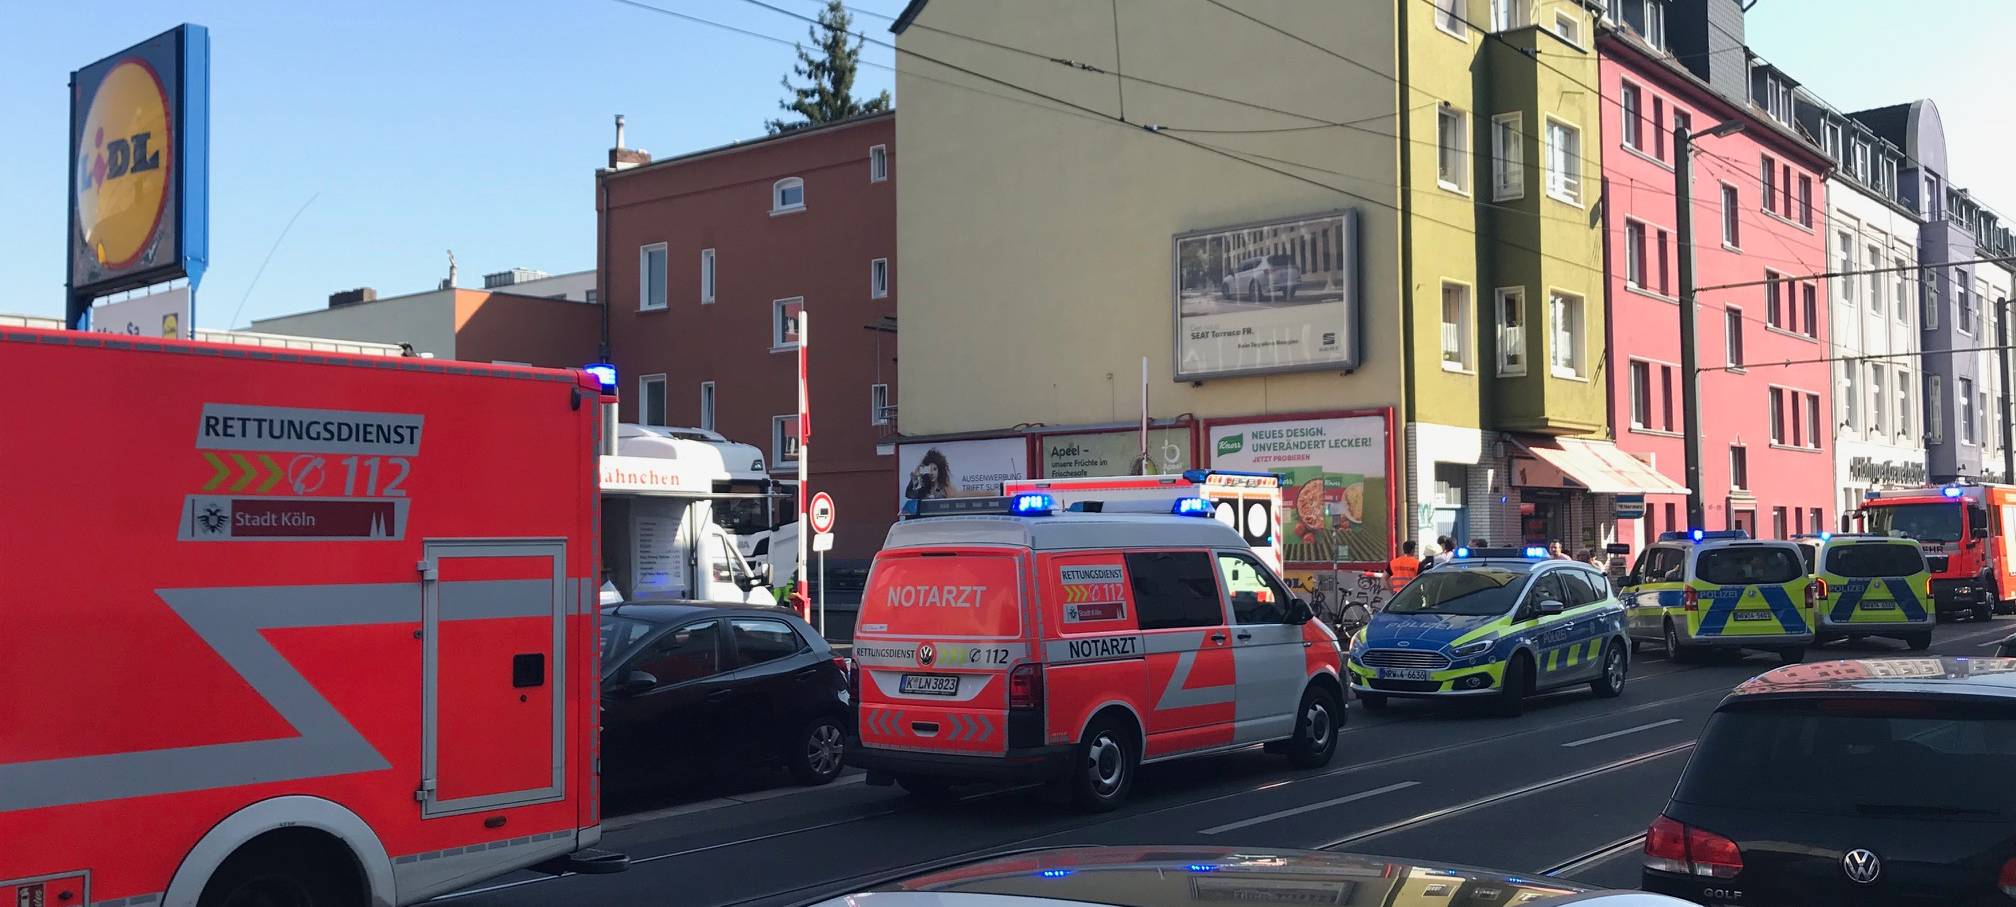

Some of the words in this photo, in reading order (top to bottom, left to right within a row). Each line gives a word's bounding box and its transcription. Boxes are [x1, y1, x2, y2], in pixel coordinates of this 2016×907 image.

[1191, 331, 1210, 340] SEAT
[204, 414, 419, 446] RETTUNGSDIENST
[1251, 429, 1284, 440] NEUES
[1286, 427, 1327, 438] DESIGN.
[1218, 439, 1242, 450] Knorr
[1252, 438, 1326, 453] UNVERÄNDERT
[1328, 437, 1372, 449] LECKER!
[1051, 445, 1080, 458] Apeel
[1252, 454, 1272, 463] JETZT
[1273, 453, 1311, 462] PROBIEREN
[1051, 460, 1073, 468] unsere
[1074, 458, 1098, 467] Früchte
[1100, 457, 1108, 466] im
[341, 455, 411, 497] 112
[600, 467, 680, 486] ähnchen
[961, 472, 1022, 482] AUSSENWERBUNG
[961, 483, 984, 492] TRIFFT
[235, 512, 277, 527] Stadt
[281, 512, 316, 527] Köln
[1062, 569, 1123, 580] RETTUNGSDIENST
[1103, 582, 1124, 602] 112
[1700, 590, 1738, 599] POLIZEI
[1829, 584, 1864, 593] POLIZEI
[886, 585, 988, 608] NOTARZT
[856, 647, 915, 660] RETTUNGSDIENST
[1069, 637, 1137, 659] NOTARZT
[985, 649, 1010, 664] 112
[906, 676, 914, 689] K
[1703, 887, 1743, 899] GOLF
